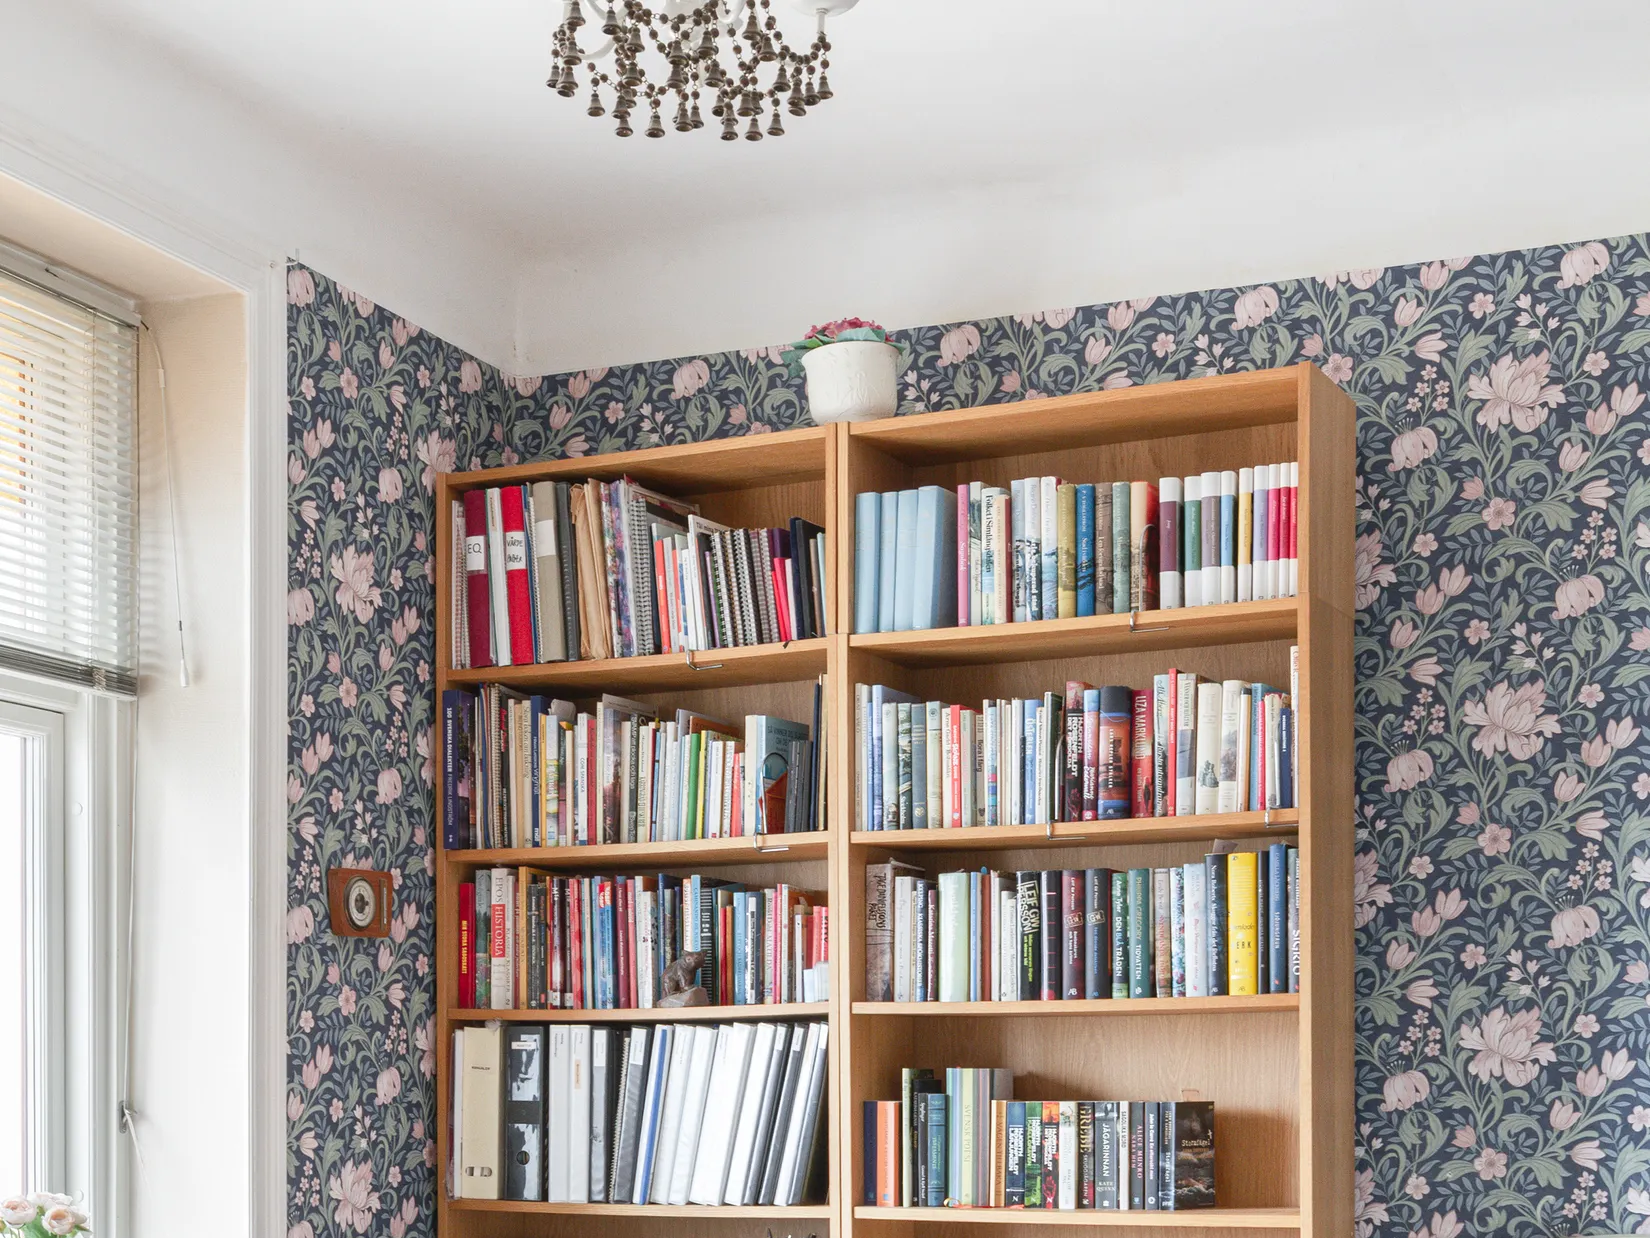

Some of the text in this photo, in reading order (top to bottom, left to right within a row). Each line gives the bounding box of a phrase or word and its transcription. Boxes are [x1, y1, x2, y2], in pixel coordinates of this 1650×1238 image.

[984, 494, 994, 516] Folket
[466, 542, 483, 554] EQ
[1026, 718, 1037, 755] ÖSTERLEN
[1134, 695, 1147, 760] LIZA MARKLUND
[1210, 864, 1218, 879] Nora
[1210, 879, 1218, 900] Roberts
[1274, 875, 1282, 902] LÄCKBERG
[494, 877, 504, 956] EPOS HISTORIA
[1017, 885, 1032, 930] PERSSON
[1024, 883, 1040, 928] LEIF GW
[1114, 898, 1124, 913] Tyler
[1115, 932, 1124, 946] BLÅ
[1274, 911, 1282, 950] SJÖJUNGFRUN
[1115, 946, 1124, 977] TRÅDEN
[995, 1122, 1003, 1150] VÄGEN
[1079, 1106, 1092, 1153] GREBE
[1102, 1123, 1111, 1177] JÄGARINNAN
